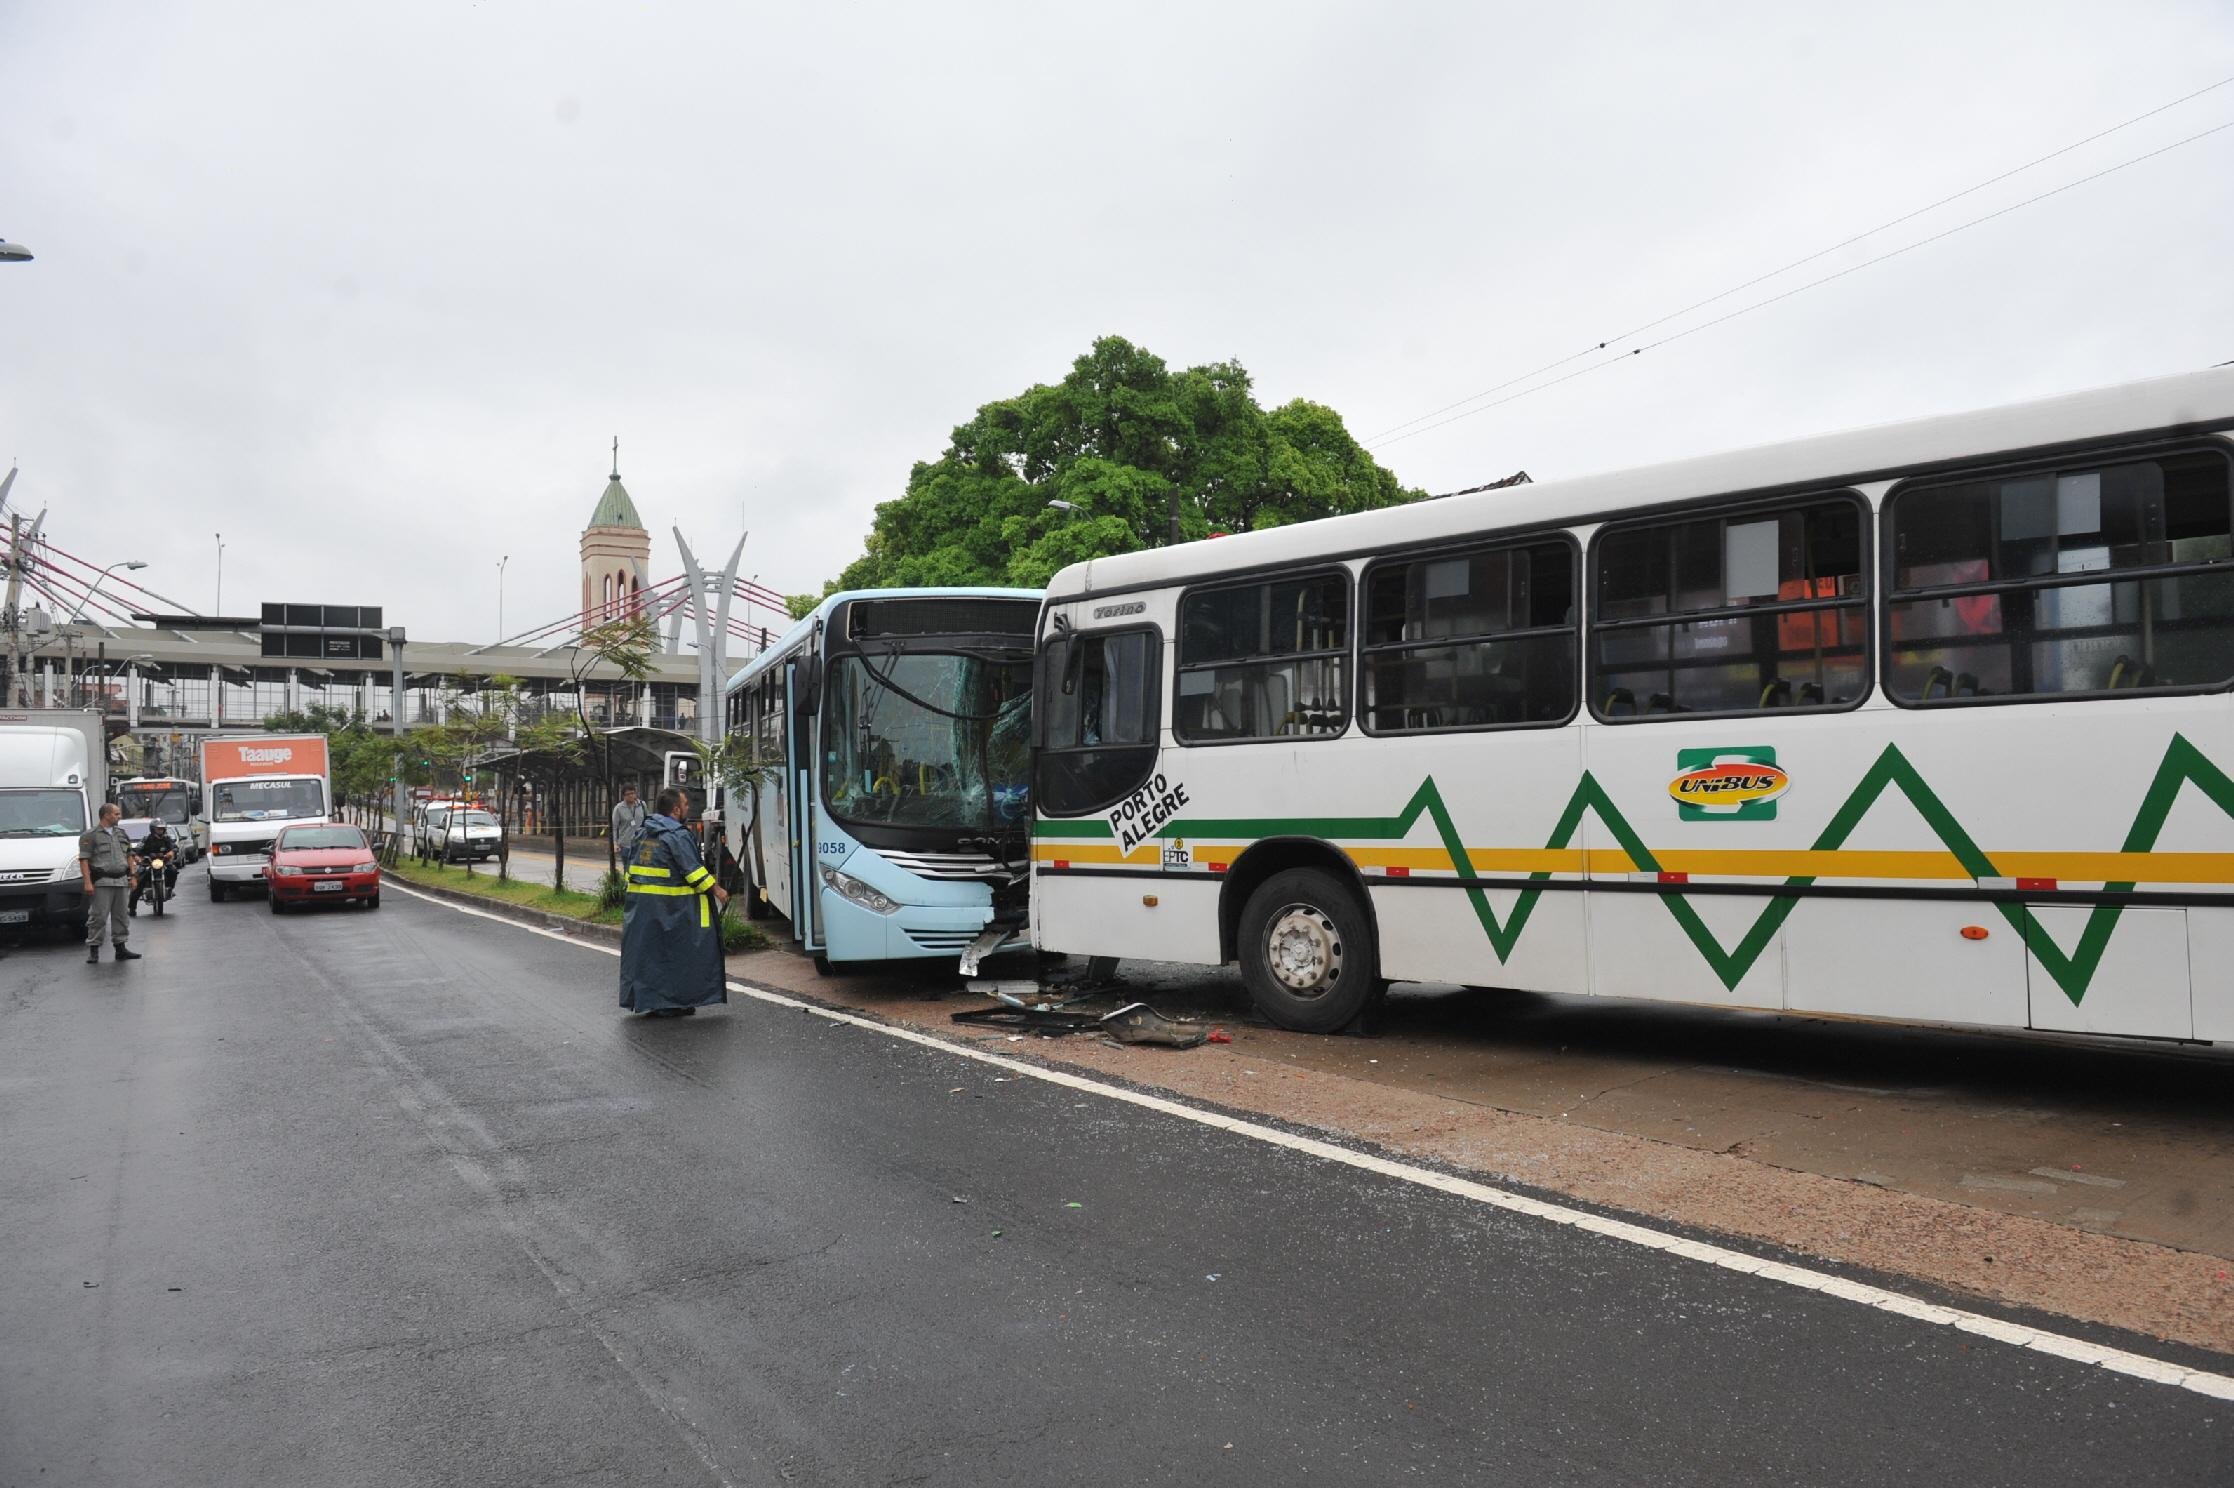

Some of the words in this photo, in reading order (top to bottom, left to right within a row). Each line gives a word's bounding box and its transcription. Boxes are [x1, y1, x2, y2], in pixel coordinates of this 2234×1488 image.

[249, 782, 292, 790] MECASUL
[1110, 773, 1167, 832] PORTO
[1680, 775, 1775, 792] UNIBUS
[1122, 783, 1190, 852] ALEGRE
